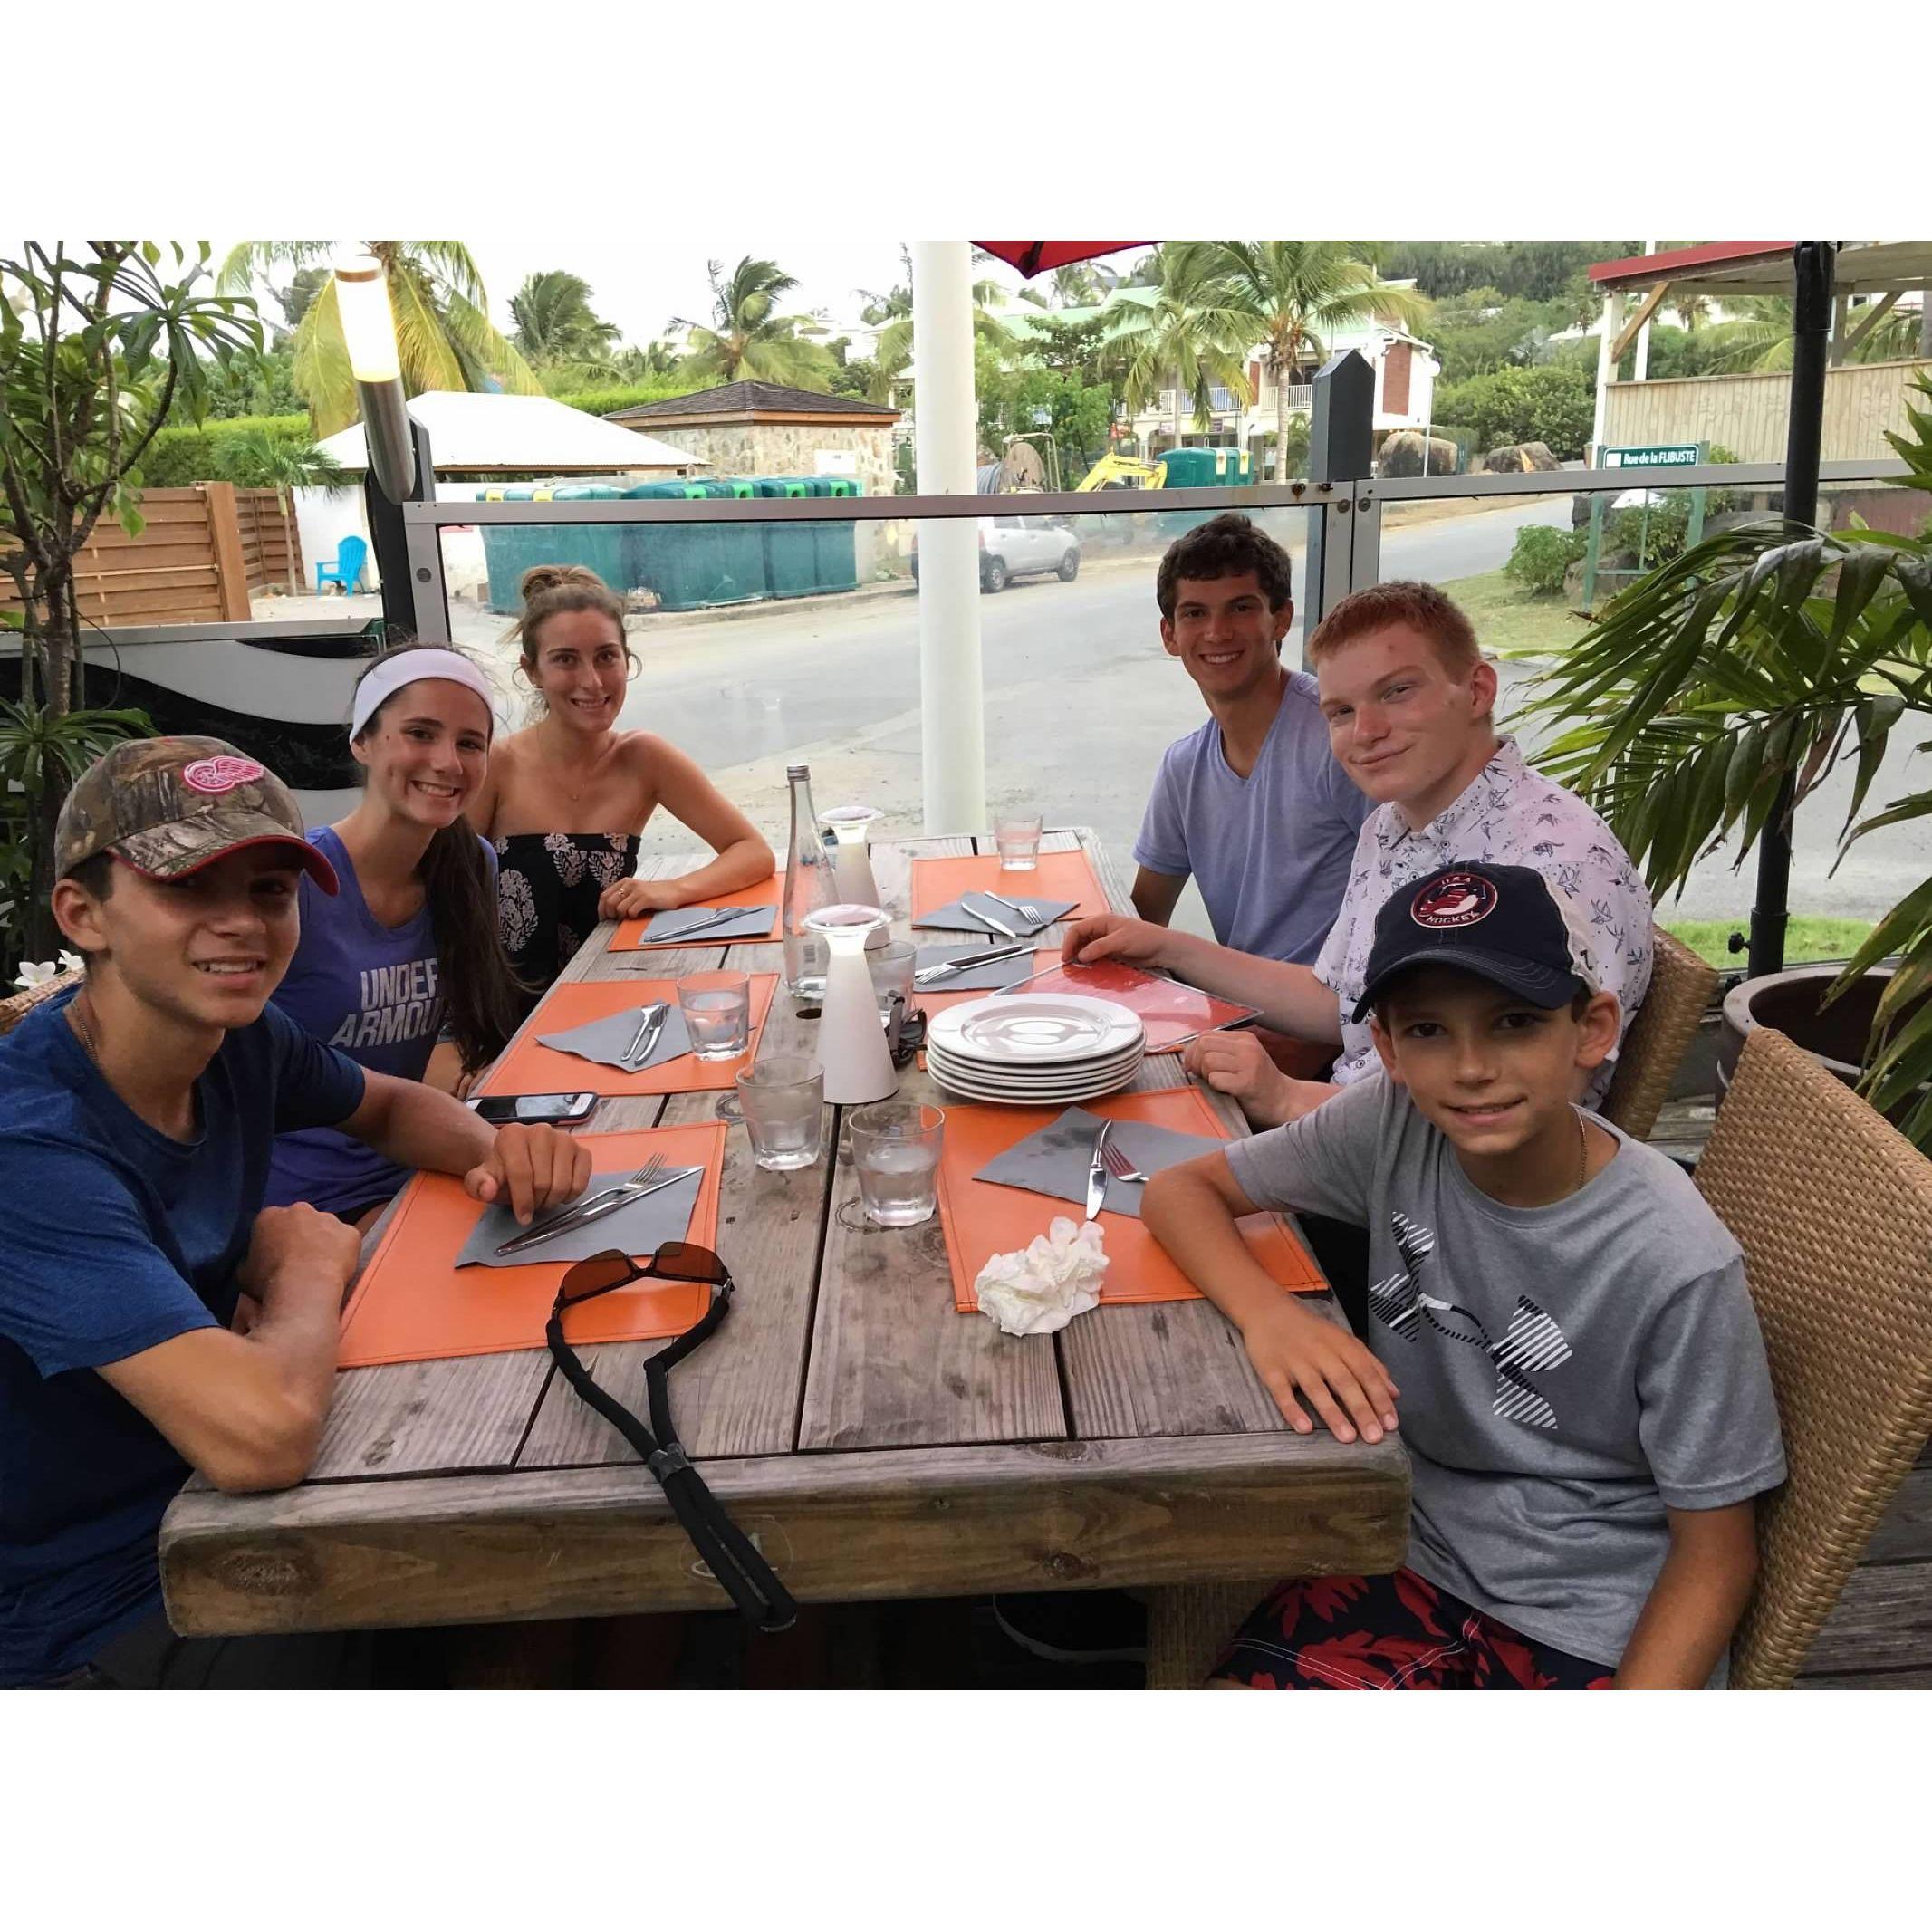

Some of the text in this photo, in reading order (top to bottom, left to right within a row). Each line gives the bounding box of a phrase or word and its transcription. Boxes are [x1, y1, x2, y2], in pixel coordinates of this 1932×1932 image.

[1623, 450, 1696, 465] Rue de la FLIBUSTE
[1427, 910, 1480, 924] HOCKEY
[327, 997, 443, 1049] ARMOU
